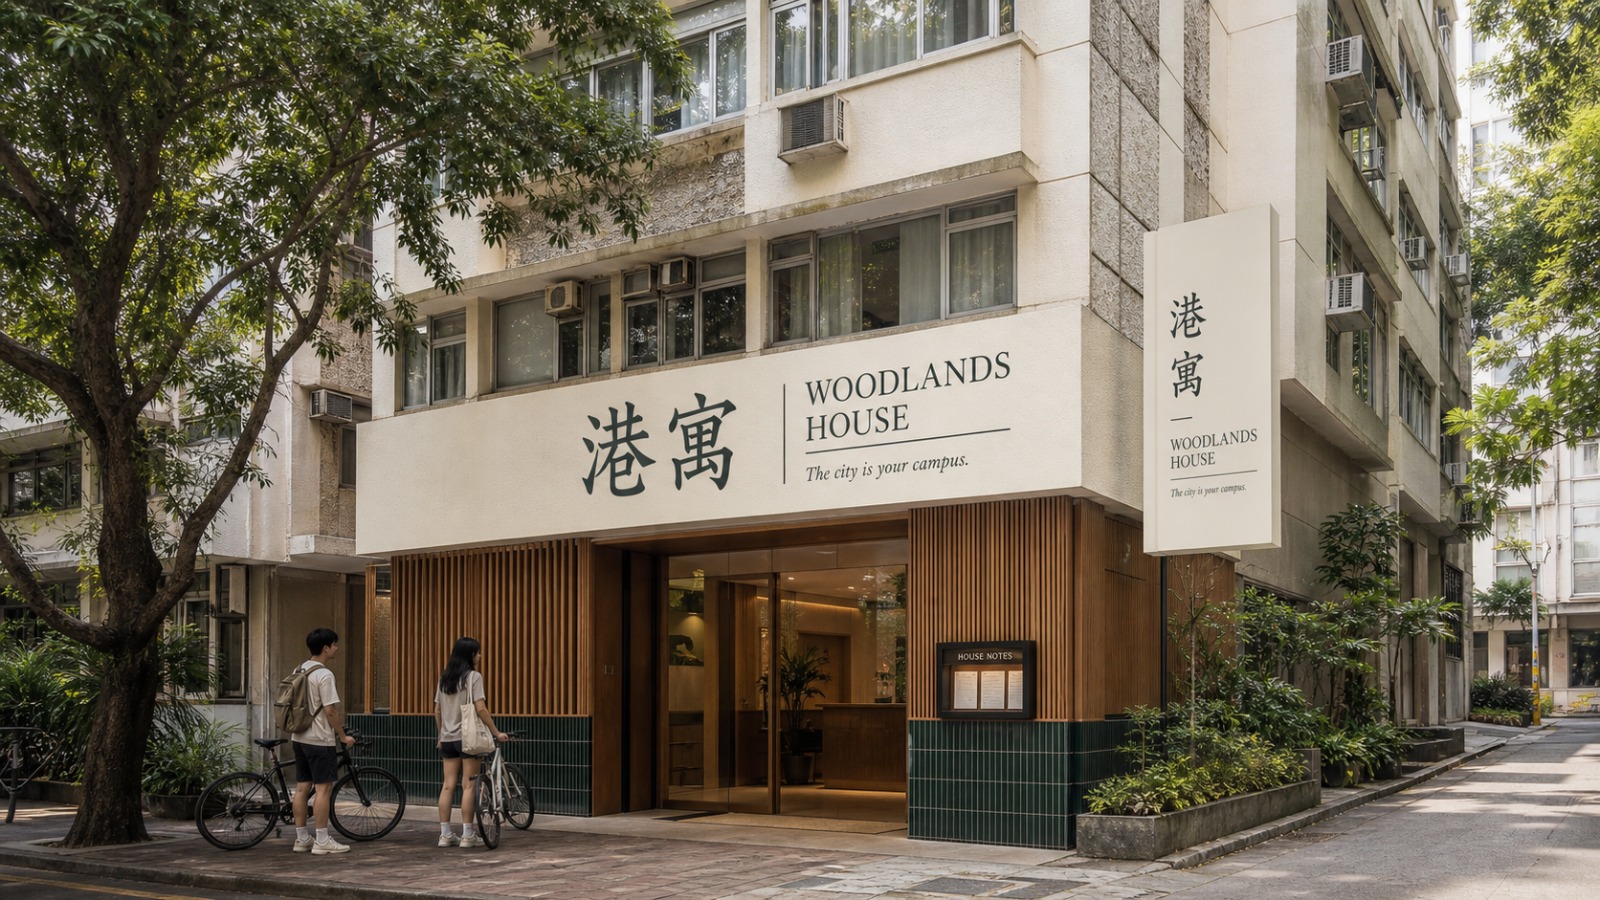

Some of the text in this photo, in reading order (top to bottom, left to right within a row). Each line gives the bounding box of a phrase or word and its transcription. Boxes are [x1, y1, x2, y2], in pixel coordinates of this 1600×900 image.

[1170, 292, 1207, 399] 港寓
[806, 351, 1011, 406] WOODLANDS
[806, 404, 910, 441] HOUSE
[582, 393, 737, 497] 港寓
[1170, 428, 1258, 451] WOODLANDS
[806, 455, 969, 483] The city is your campus.
[1170, 452, 1216, 470] HOUSE
[1170, 488, 1183, 498] The
[1184, 488, 1196, 498] city
[1204, 487, 1219, 497] your
[957, 651, 1013, 661] HOUSE NOTES
